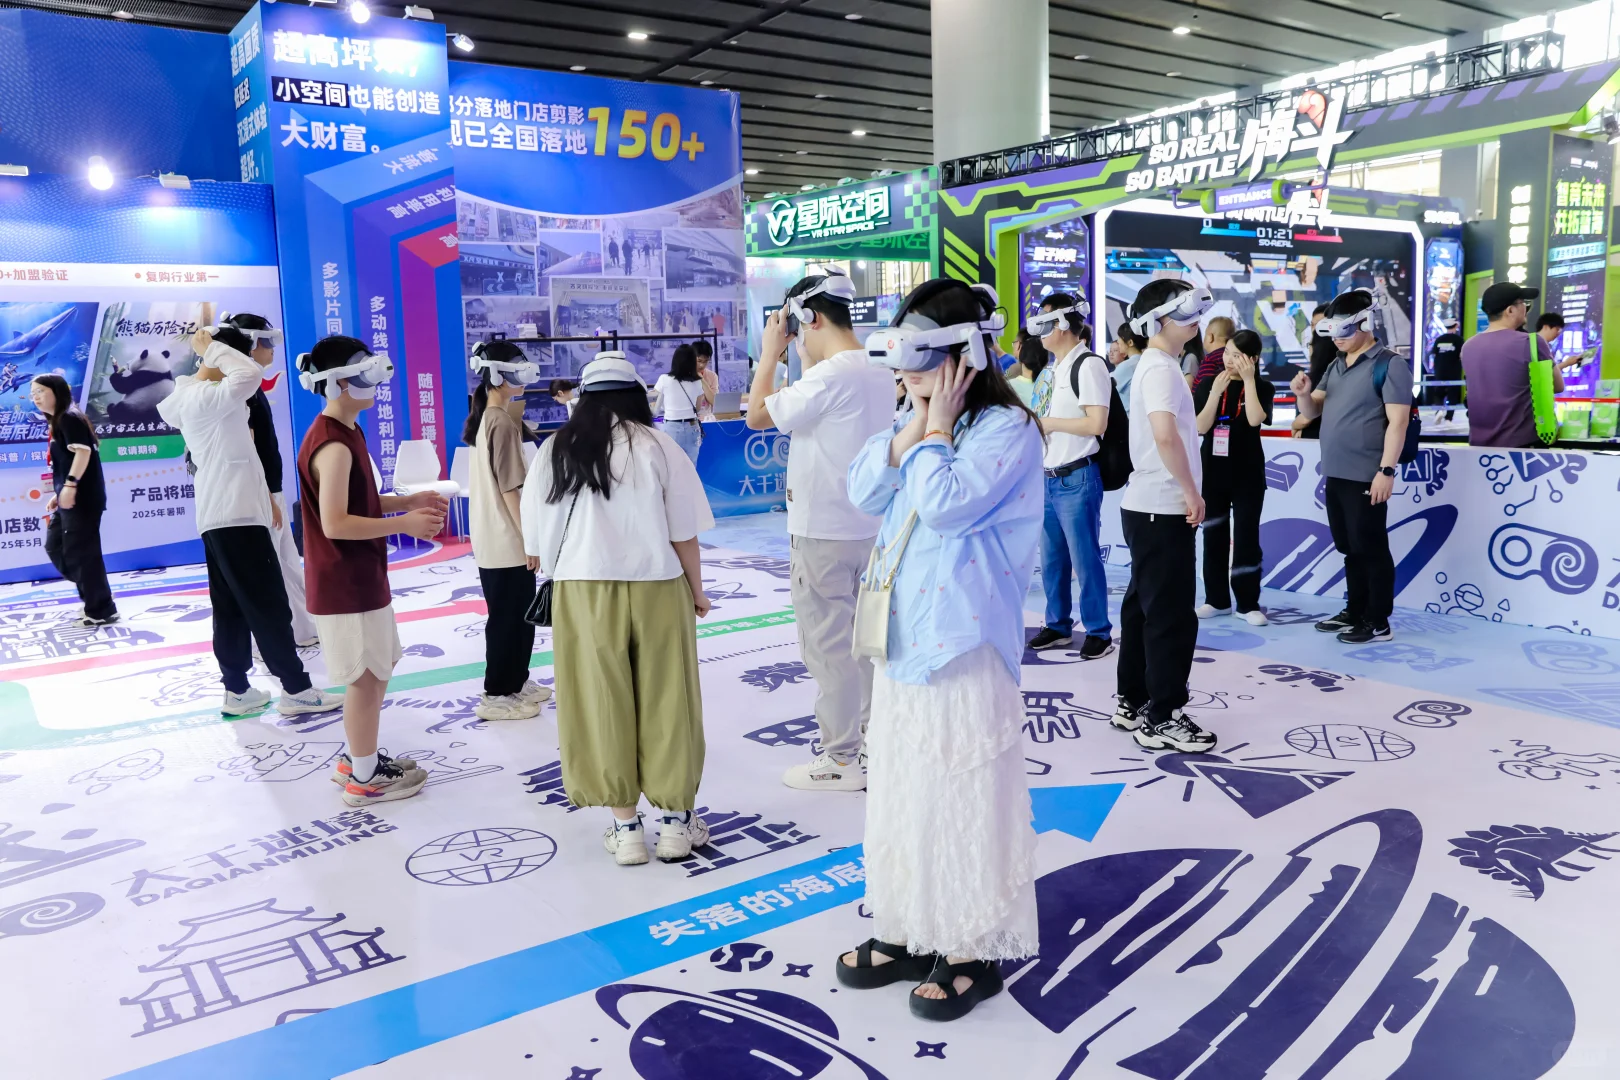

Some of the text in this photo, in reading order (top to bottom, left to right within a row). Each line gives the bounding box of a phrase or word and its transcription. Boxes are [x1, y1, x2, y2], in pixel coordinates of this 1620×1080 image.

[273, 29, 418, 78] 超高坪，
[276, 78, 440, 115] 小空间也能创造
[449, 95, 585, 126] 分落地门店剪影
[281, 118, 381, 154] 大财富。
[587, 106, 705, 162] 150+
[1148, 129, 1241, 165] SO REAL
[1124, 155, 1238, 193] SO BATTLE
[386, 185, 456, 219] 利用率高
[796, 185, 890, 233] 星际空间
[1256, 227, 1293, 239] 01:21
[145, 271, 220, 283] 复购行业第一
[322, 262, 343, 335] 多影片同
[115, 318, 199, 338] 熊猫历险记
[370, 295, 397, 490] 多动线场地利用率高
[418, 372, 437, 456] 随到随播
[117, 444, 158, 456] 敬请期待
[130, 484, 195, 503] 产品将增
[0, 516, 41, 535] 店数
[132, 506, 186, 519] 2025年暑期
[130, 823, 399, 907] DAQIANMIJING
[649, 856, 866, 946] 失落的海底
